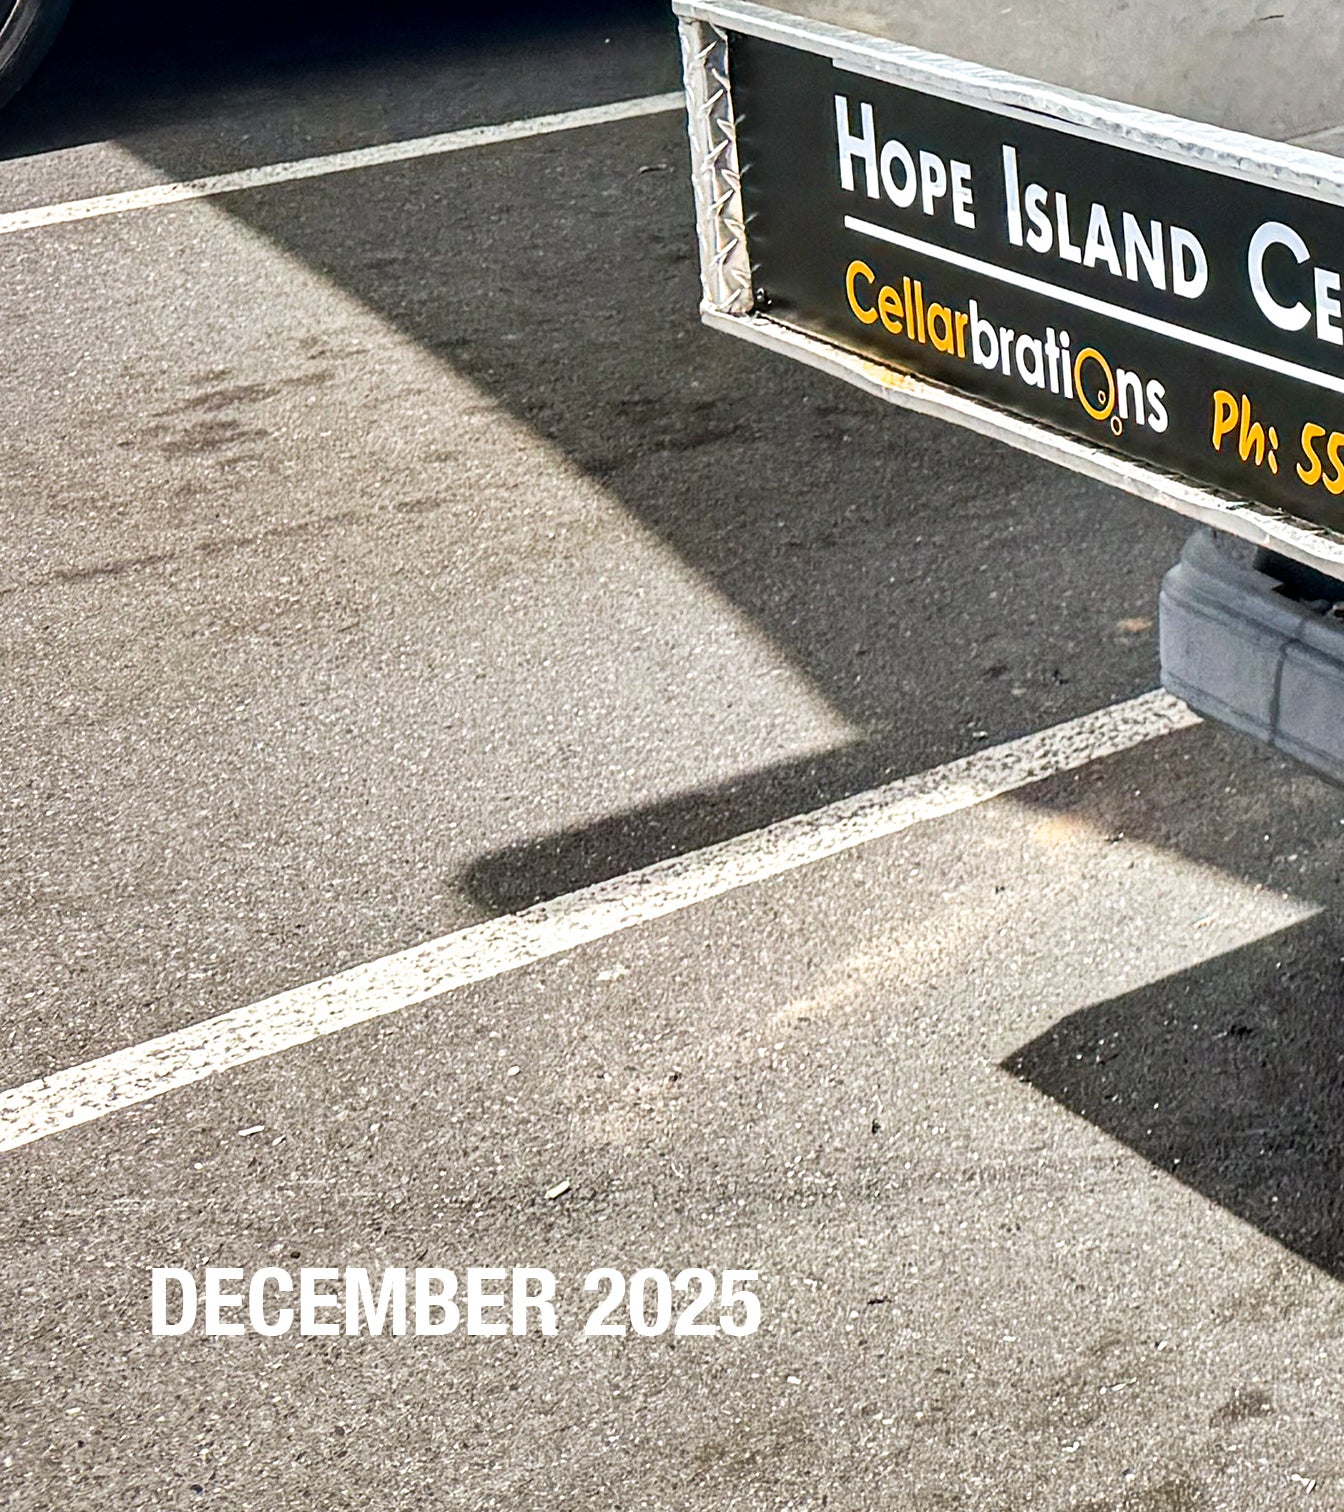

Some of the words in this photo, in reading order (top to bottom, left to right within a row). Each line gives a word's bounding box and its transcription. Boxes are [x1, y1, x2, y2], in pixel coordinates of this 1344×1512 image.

[833, 95, 976, 229] HOPE
[1003, 145, 1209, 301] ISLAND
[844, 259, 1168, 436] Cellarbrations
[1212, 388, 1279, 476] Ph:
